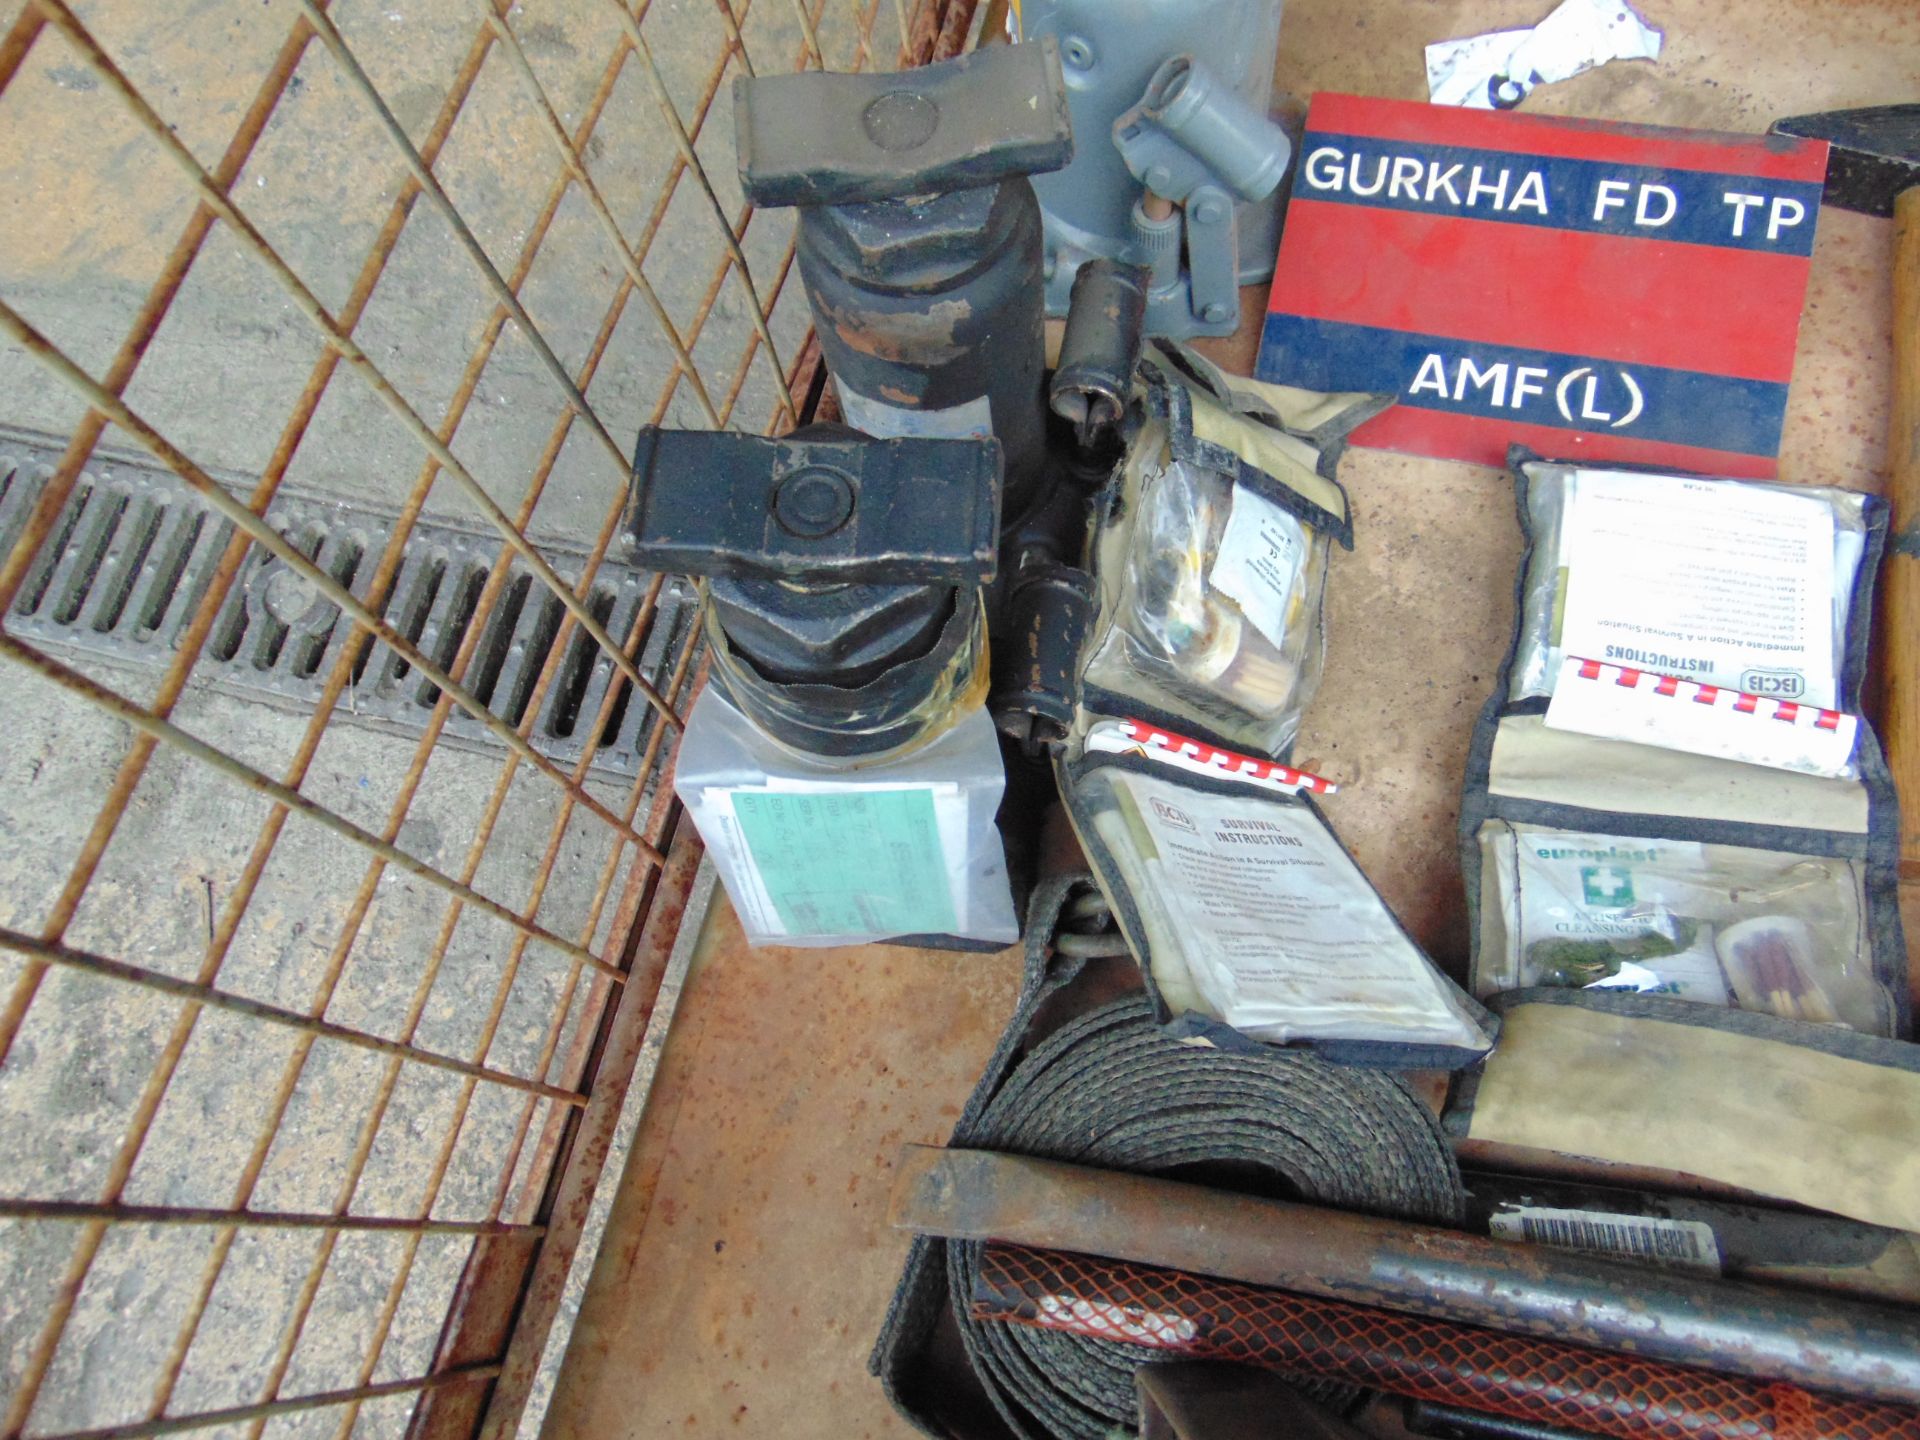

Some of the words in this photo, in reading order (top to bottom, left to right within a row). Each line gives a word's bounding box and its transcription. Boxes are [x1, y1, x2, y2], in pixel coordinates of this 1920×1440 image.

[1304, 146, 1549, 216] GURKHA
[1593, 179, 1678, 228] FD
[1723, 192, 1806, 241] TP
[1408, 353, 1644, 429] AMF(L)
[1597, 620, 1642, 634] Situation
[1644, 627, 1684, 641] Survival
[1710, 636, 1744, 647] Action
[1746, 641, 1805, 653] Immediate
[1605, 644, 1715, 673] INSTRUCTIONS
[1747, 675, 1798, 693] BCB
[1219, 818, 1281, 833] SURVIVAL
[1214, 831, 1304, 848] INSTRUCTIONS
[1555, 922, 1635, 935] CLEANSING
